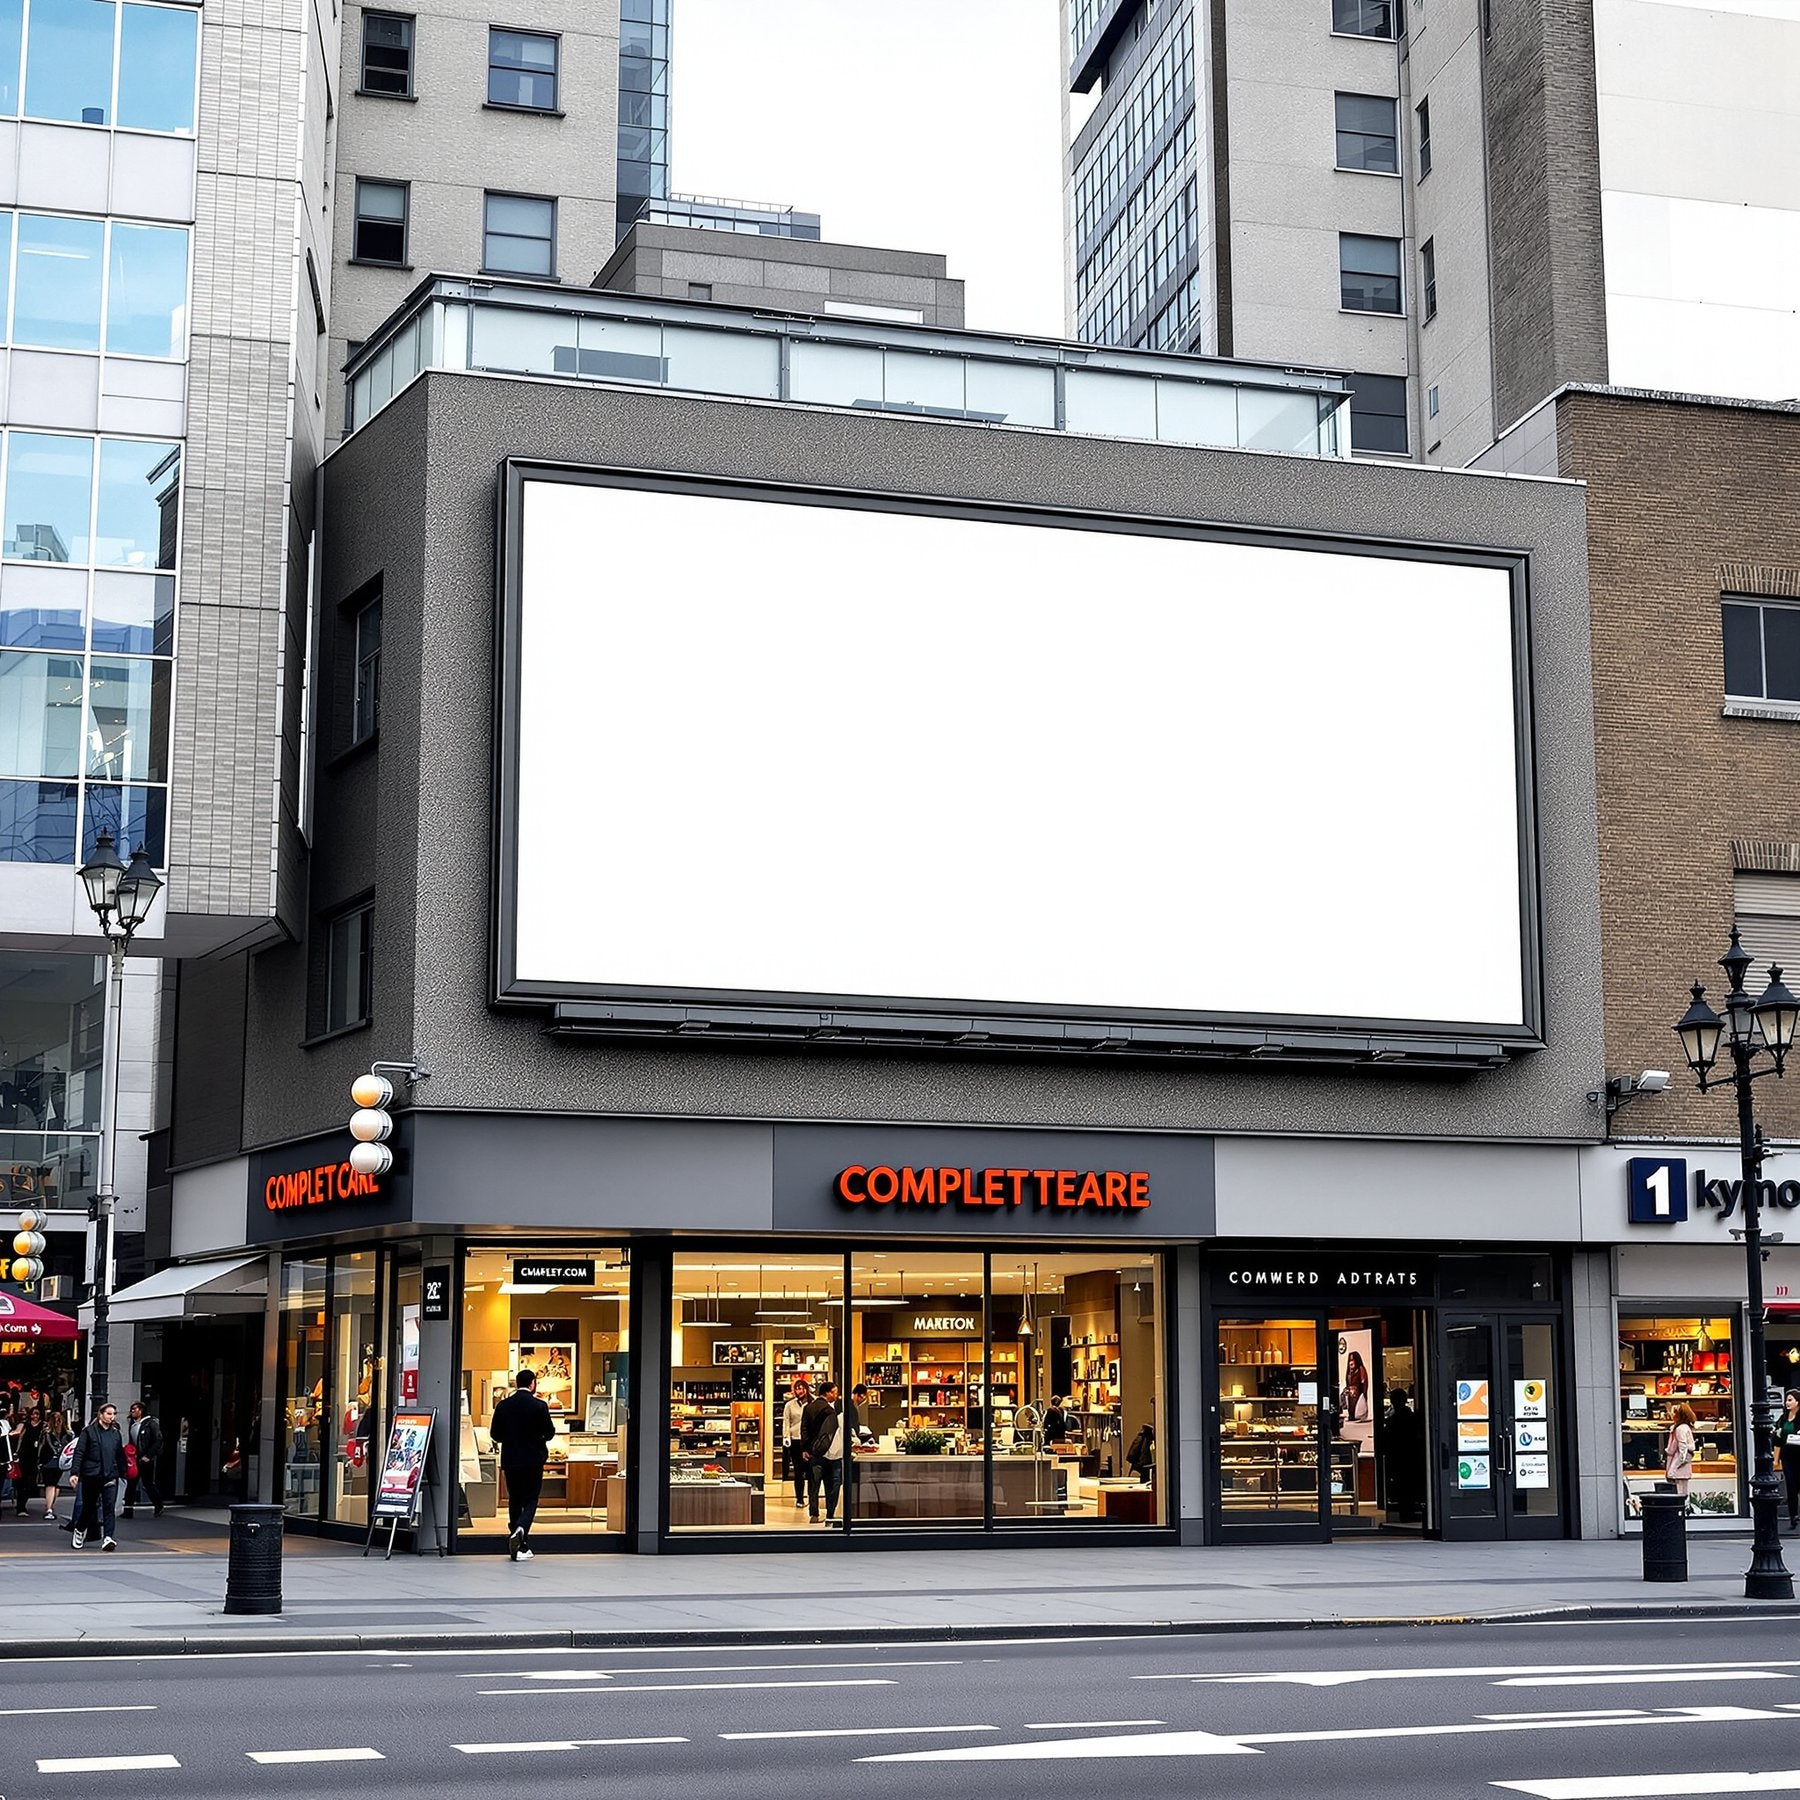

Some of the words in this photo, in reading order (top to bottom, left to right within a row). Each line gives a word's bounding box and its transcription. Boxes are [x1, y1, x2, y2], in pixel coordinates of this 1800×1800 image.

[266, 1164, 337, 1210] COMPLET
[839, 1165, 1150, 1208] COMPLETTEARE
[1646, 1165, 1670, 1216] 1
